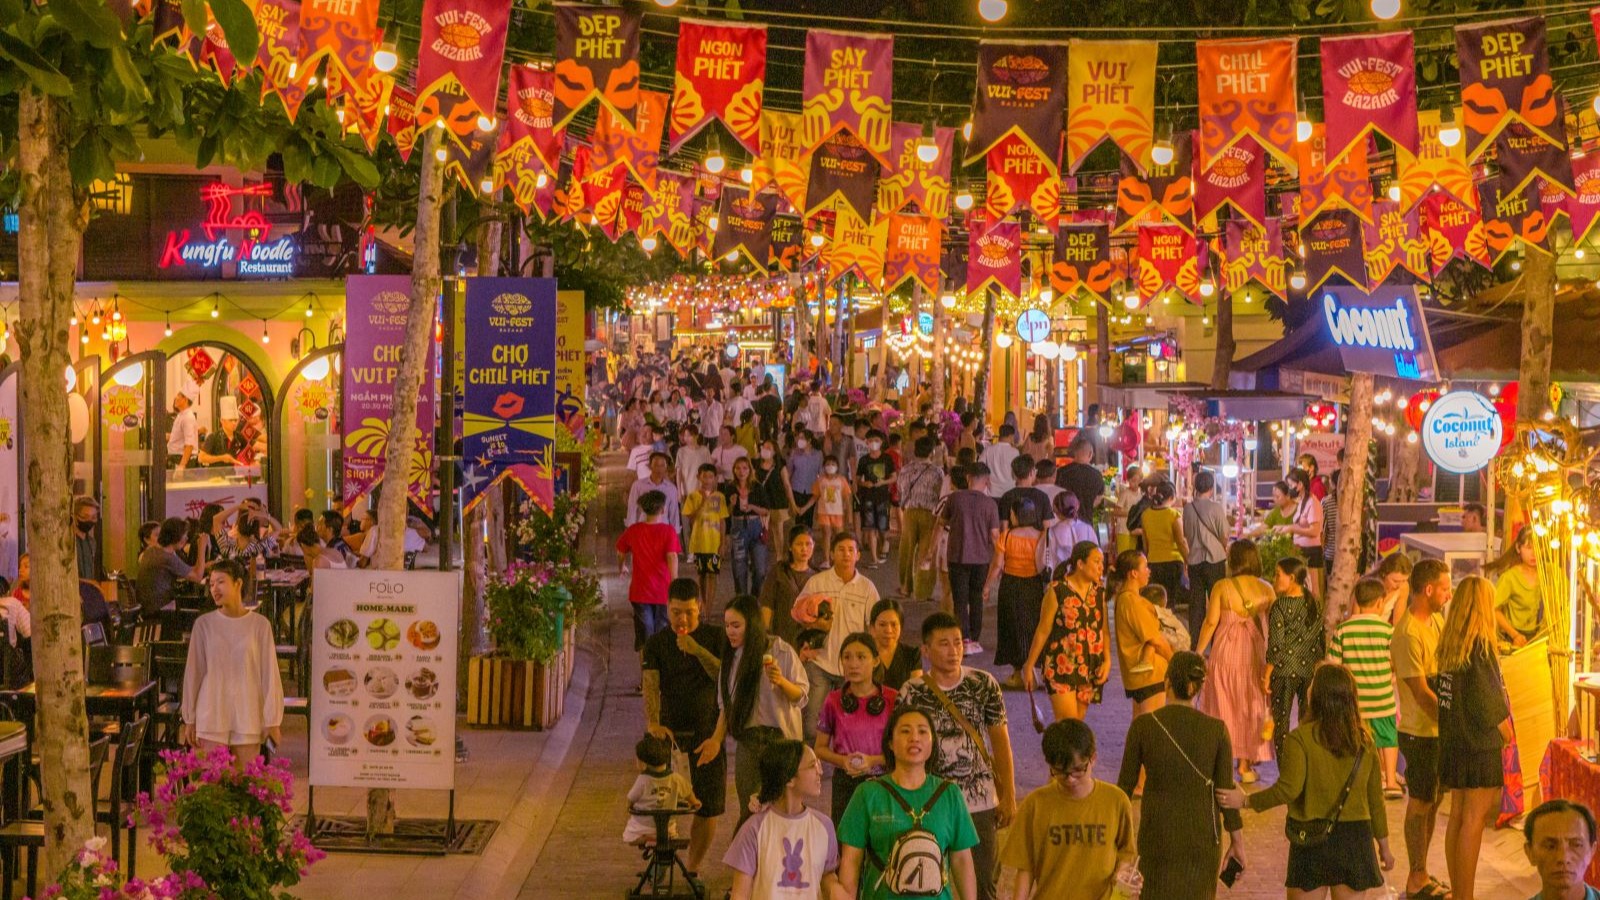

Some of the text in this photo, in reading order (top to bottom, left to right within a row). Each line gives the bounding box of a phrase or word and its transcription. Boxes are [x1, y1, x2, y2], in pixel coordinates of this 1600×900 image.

[261, 4, 288, 22] SAY
[434, 9, 492, 37] VUI-FEST
[578, 14, 621, 36] ĐẸP
[431, 39, 484, 62] BAZAAR
[699, 39, 743, 57] NGON
[1481, 32, 1526, 56] ĐẸP
[831, 47, 867, 69] SAY
[1219, 49, 1268, 71] CHILL
[1087, 60, 1127, 81] VUI
[1337, 57, 1403, 79] VUI-FEST
[987, 84, 1051, 100] VUI-FEST
[1342, 88, 1401, 110] BAZAAR
[768, 124, 796, 141] VUI
[658, 179, 681, 193] SAY
[1207, 172, 1251, 188] BAZAAR
[1380, 211, 1401, 227] SAY
[901, 222, 929, 236] CHILL
[159, 230, 294, 268] Kungfu Noodle
[975, 233, 1014, 250] VUI-FEST
[1152, 235, 1182, 246] NGON
[240, 260, 293, 273] Restaurant
[977, 253, 1012, 268] BAZAAR
[489, 316, 534, 327] VUI-FEST
[1323, 294, 1415, 351] Coconut
[491, 343, 529, 368] CHỢ
[351, 367, 384, 384] VUI
[469, 365, 508, 385] CHILL
[109, 405, 130, 416] 40K
[1433, 416, 1493, 434] Coconut
[1303, 439, 1340, 449] Yakult
[356, 603, 415, 613] HOME-MADE
[1050, 823, 1107, 846] STATE
